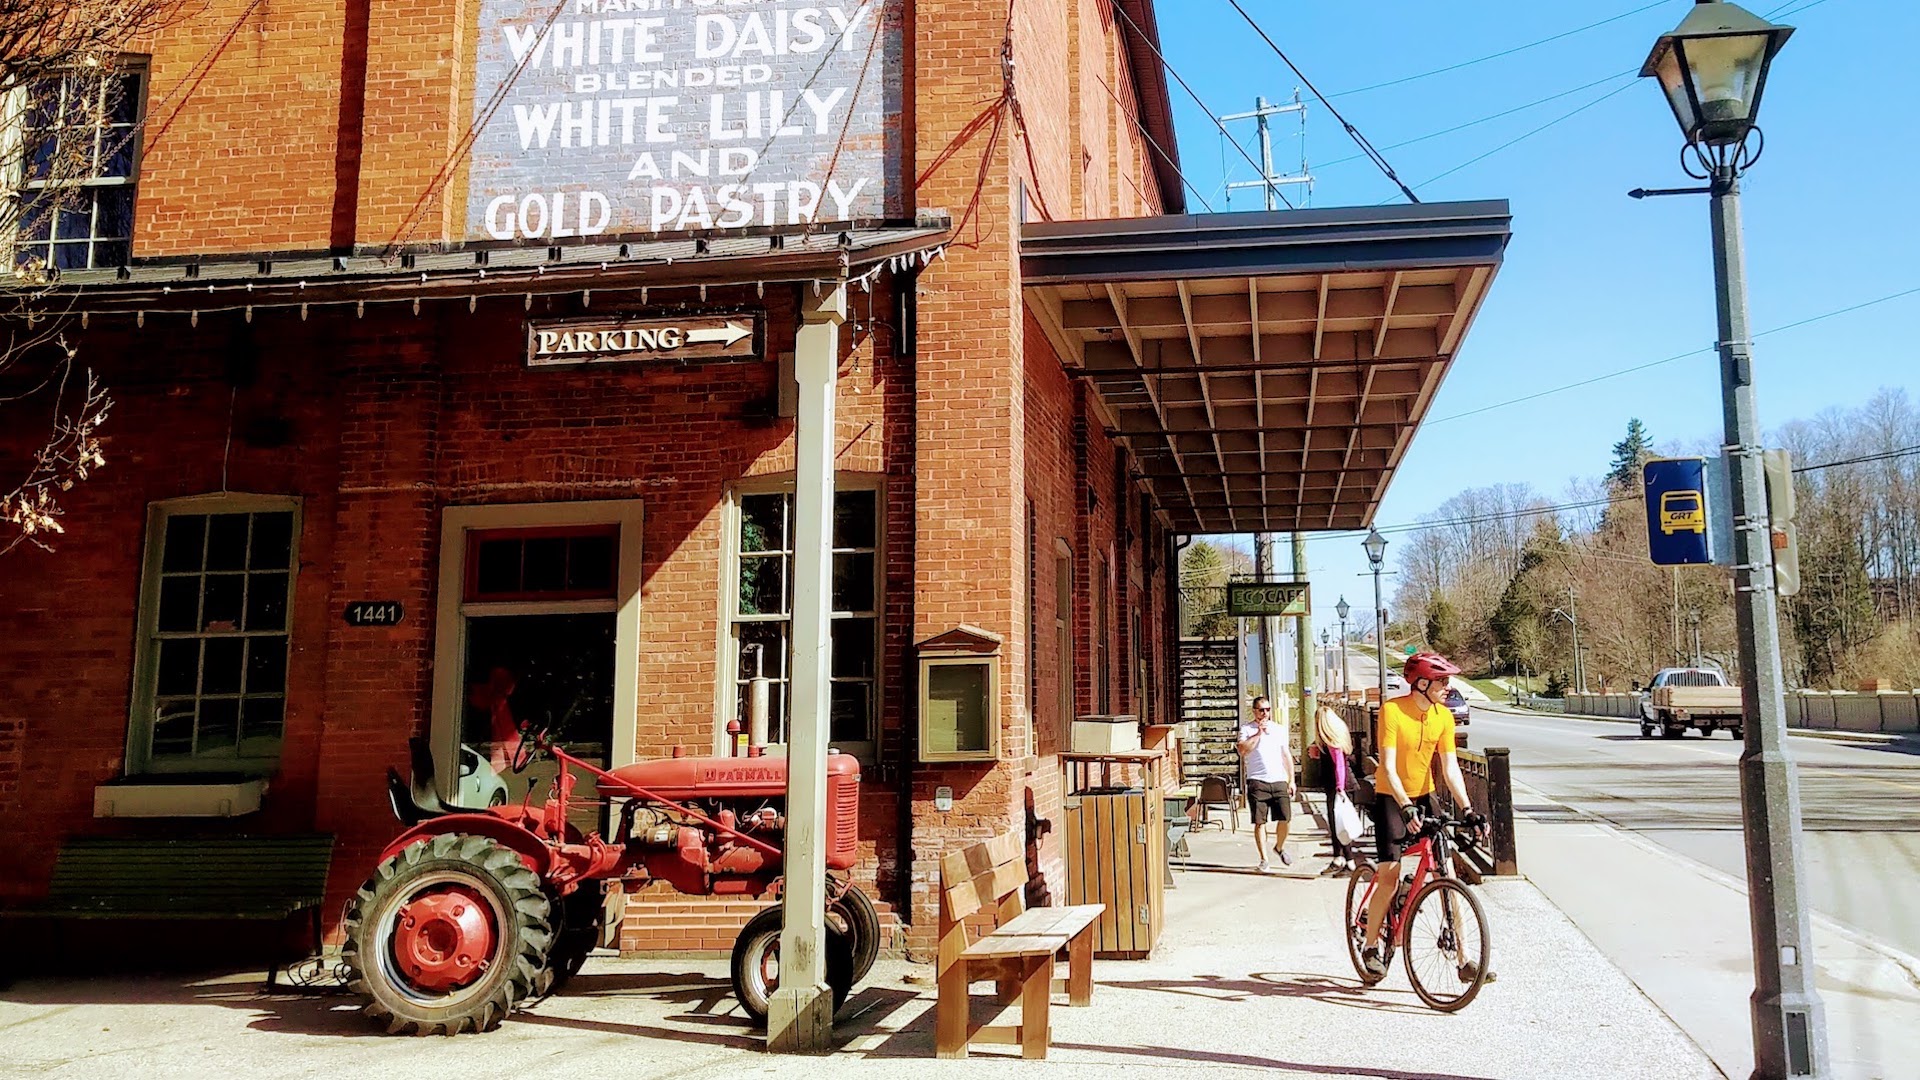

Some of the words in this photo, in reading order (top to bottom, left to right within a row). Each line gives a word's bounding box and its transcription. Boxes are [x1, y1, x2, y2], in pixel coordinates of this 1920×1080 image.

[503, 17, 665, 68] WHITE
[695, 5, 869, 59] DAISY
[575, 64, 773, 94] BLENDED
[512, 96, 679, 151] WHITE
[709, 87, 849, 141] LILY
[627, 147, 759, 180] AND
[484, 190, 612, 240] GOLD
[651, 177, 870, 232] PASTRY
[536, 327, 681, 355] PARKING
[1670, 512, 1693, 520] GRT
[353, 605, 396, 623] 1441
[718, 770, 782, 781] FARMALL
